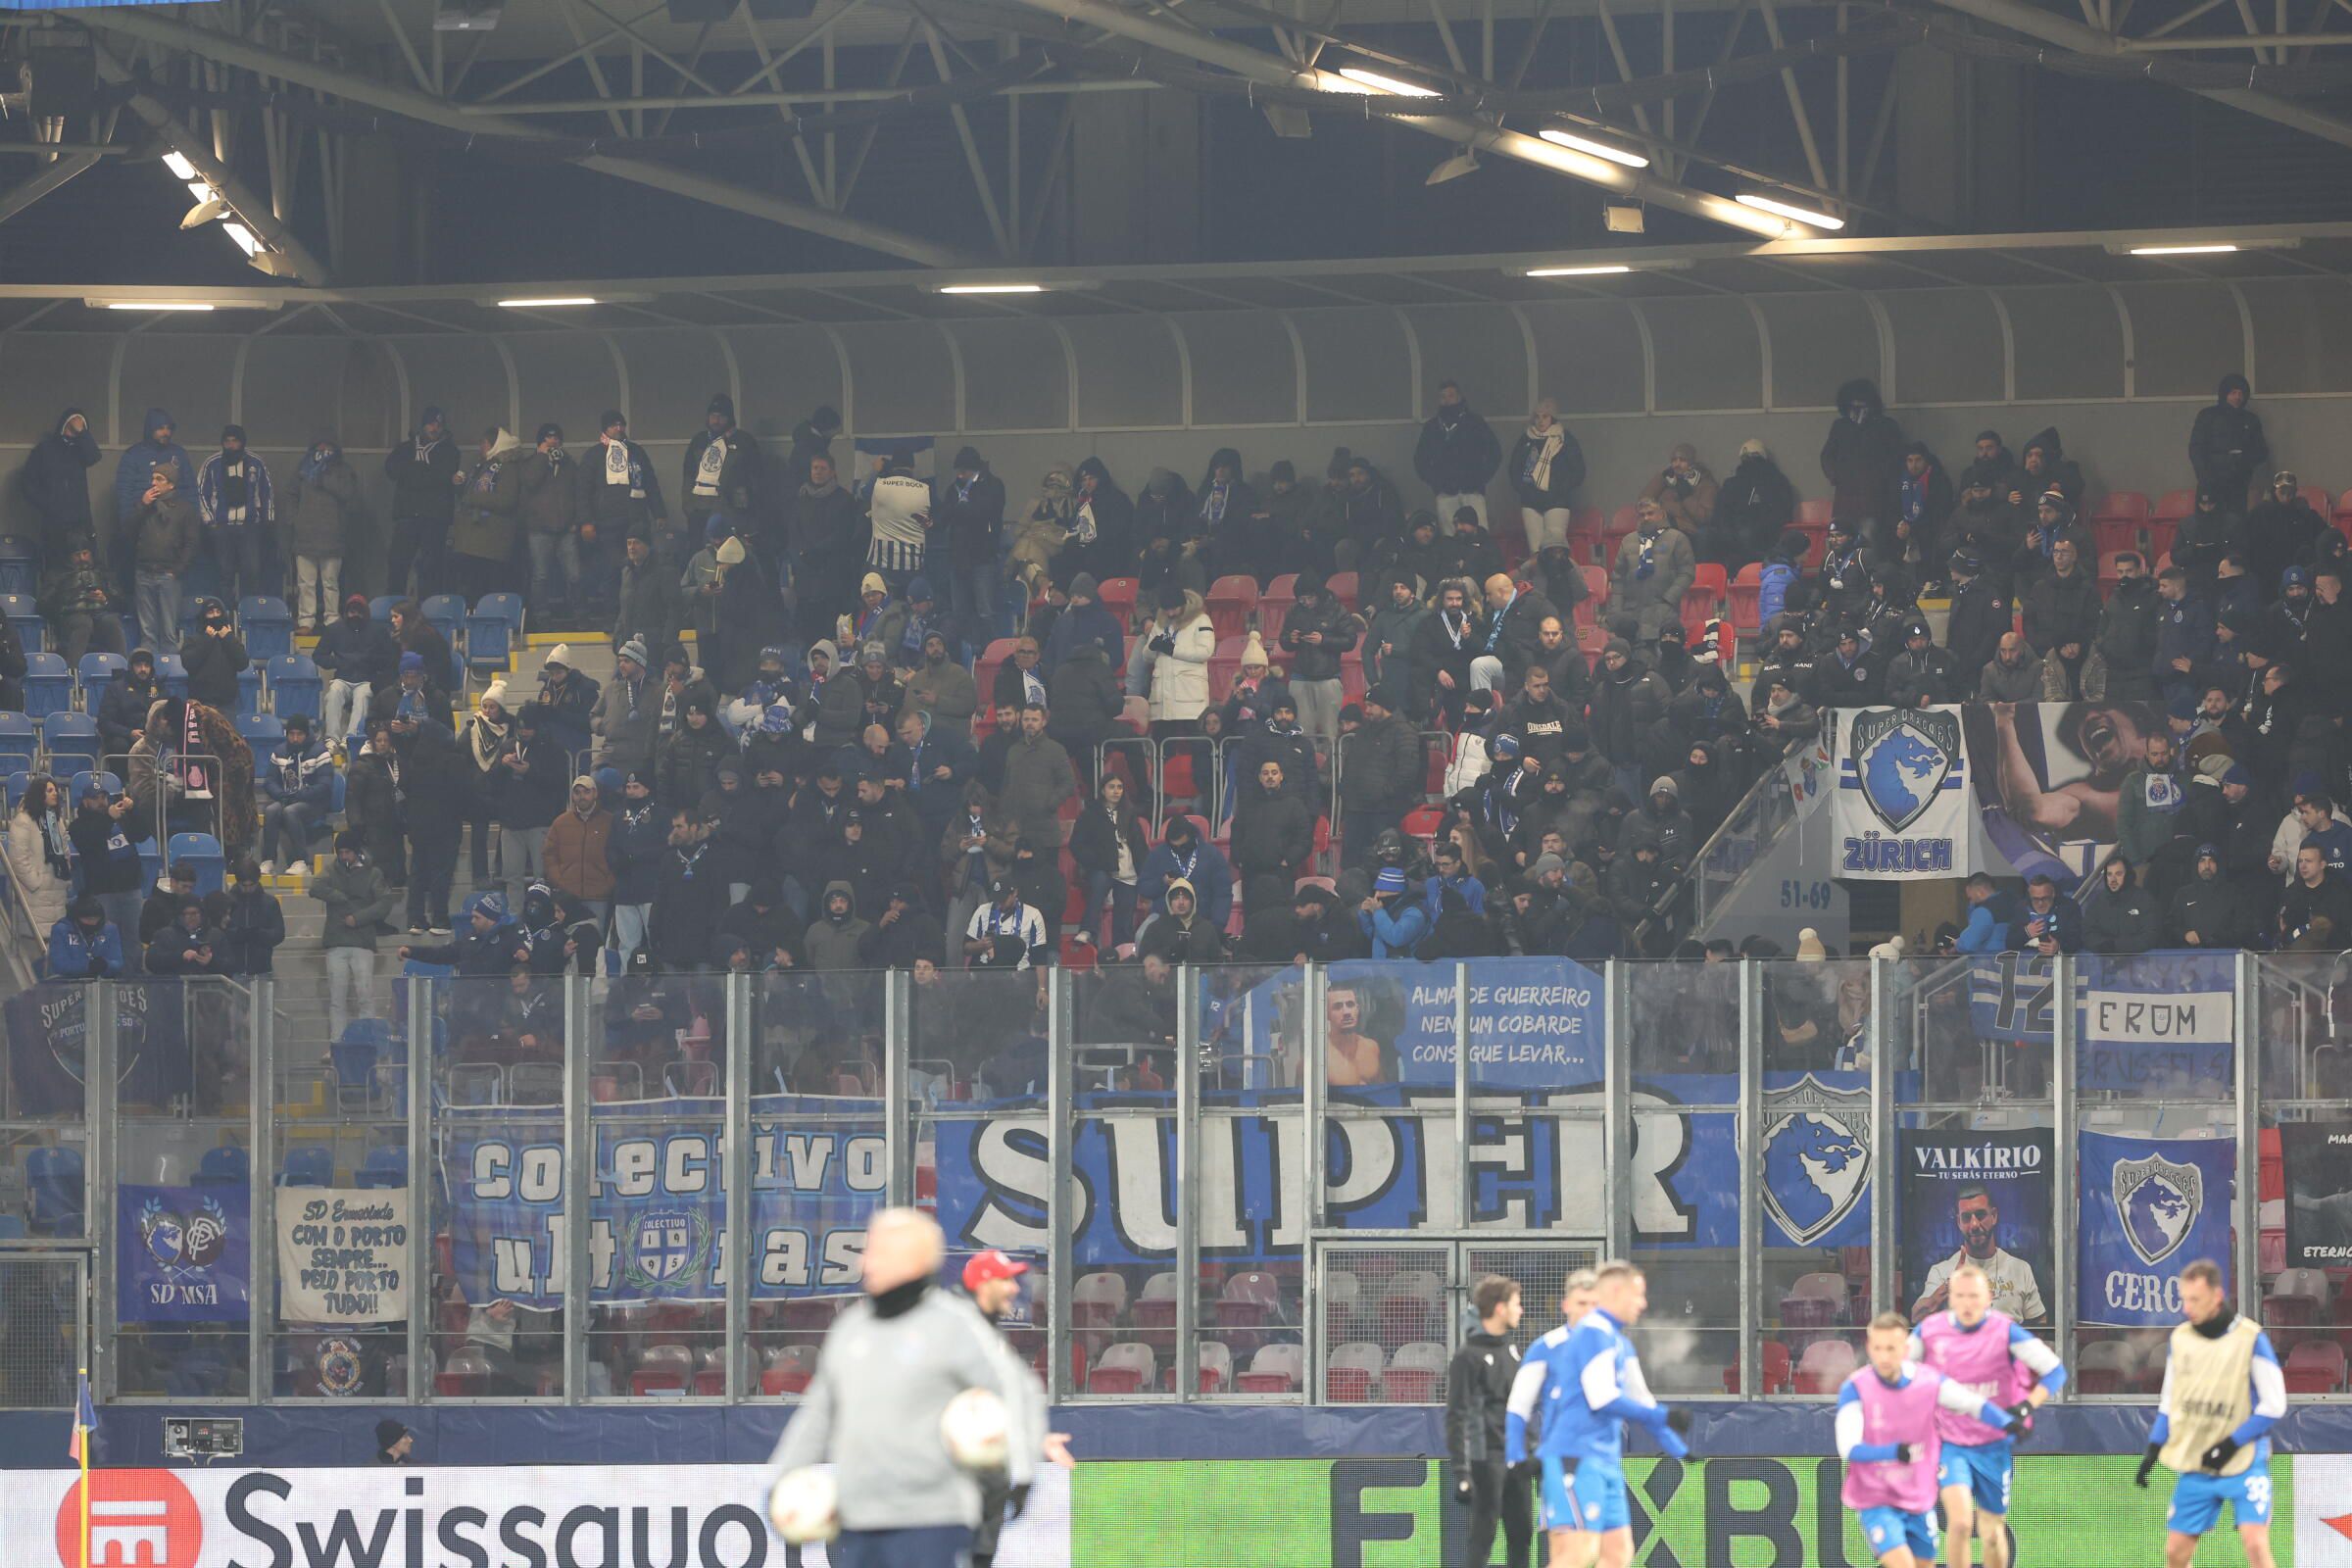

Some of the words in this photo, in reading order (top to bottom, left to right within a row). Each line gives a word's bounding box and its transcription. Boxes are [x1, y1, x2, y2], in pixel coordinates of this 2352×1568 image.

[1857, 714, 1897, 751] SUPER
[1842, 830, 1952, 872] ZÜRICH
[1780, 879, 1832, 910] 51-69
[1411, 985, 1456, 1006] ALMA
[1469, 986, 1490, 1004] DE
[1494, 986, 1591, 1008] GUERREIRO
[40, 990, 82, 1029] SUPER
[1421, 1015, 1494, 1034] NENUM
[1497, 1015, 1583, 1035] COBARDE
[1412, 1045, 1503, 1064] CONSGUE
[1508, 1044, 1585, 1065] LEVAR...
[471, 1113, 888, 1202] coecivo
[1915, 1142, 2041, 1170] VALKÍRIO
[965, 1081, 1697, 1260] SUPER
[1938, 1171, 1950, 1180] TU
[1983, 1171, 2018, 1180] ETERNO
[303, 1200, 328, 1221] SD
[291, 1224, 328, 1247] COM
[333, 1225, 346, 1247] O
[350, 1224, 407, 1248] PORTO
[673, 1232, 680, 1245] 9
[492, 1213, 868, 1295] ultas
[648, 1259, 655, 1270] 9
[671, 1257, 678, 1268] 5
[300, 1268, 339, 1291] PELO
[344, 1269, 400, 1292] PORTO
[2105, 1270, 2183, 1313] CERC
[150, 1283, 175, 1304] SD
[179, 1284, 219, 1305] MSA
[323, 1292, 378, 1315] TUDO!!
[225, 1472, 835, 1568] Swissquo
